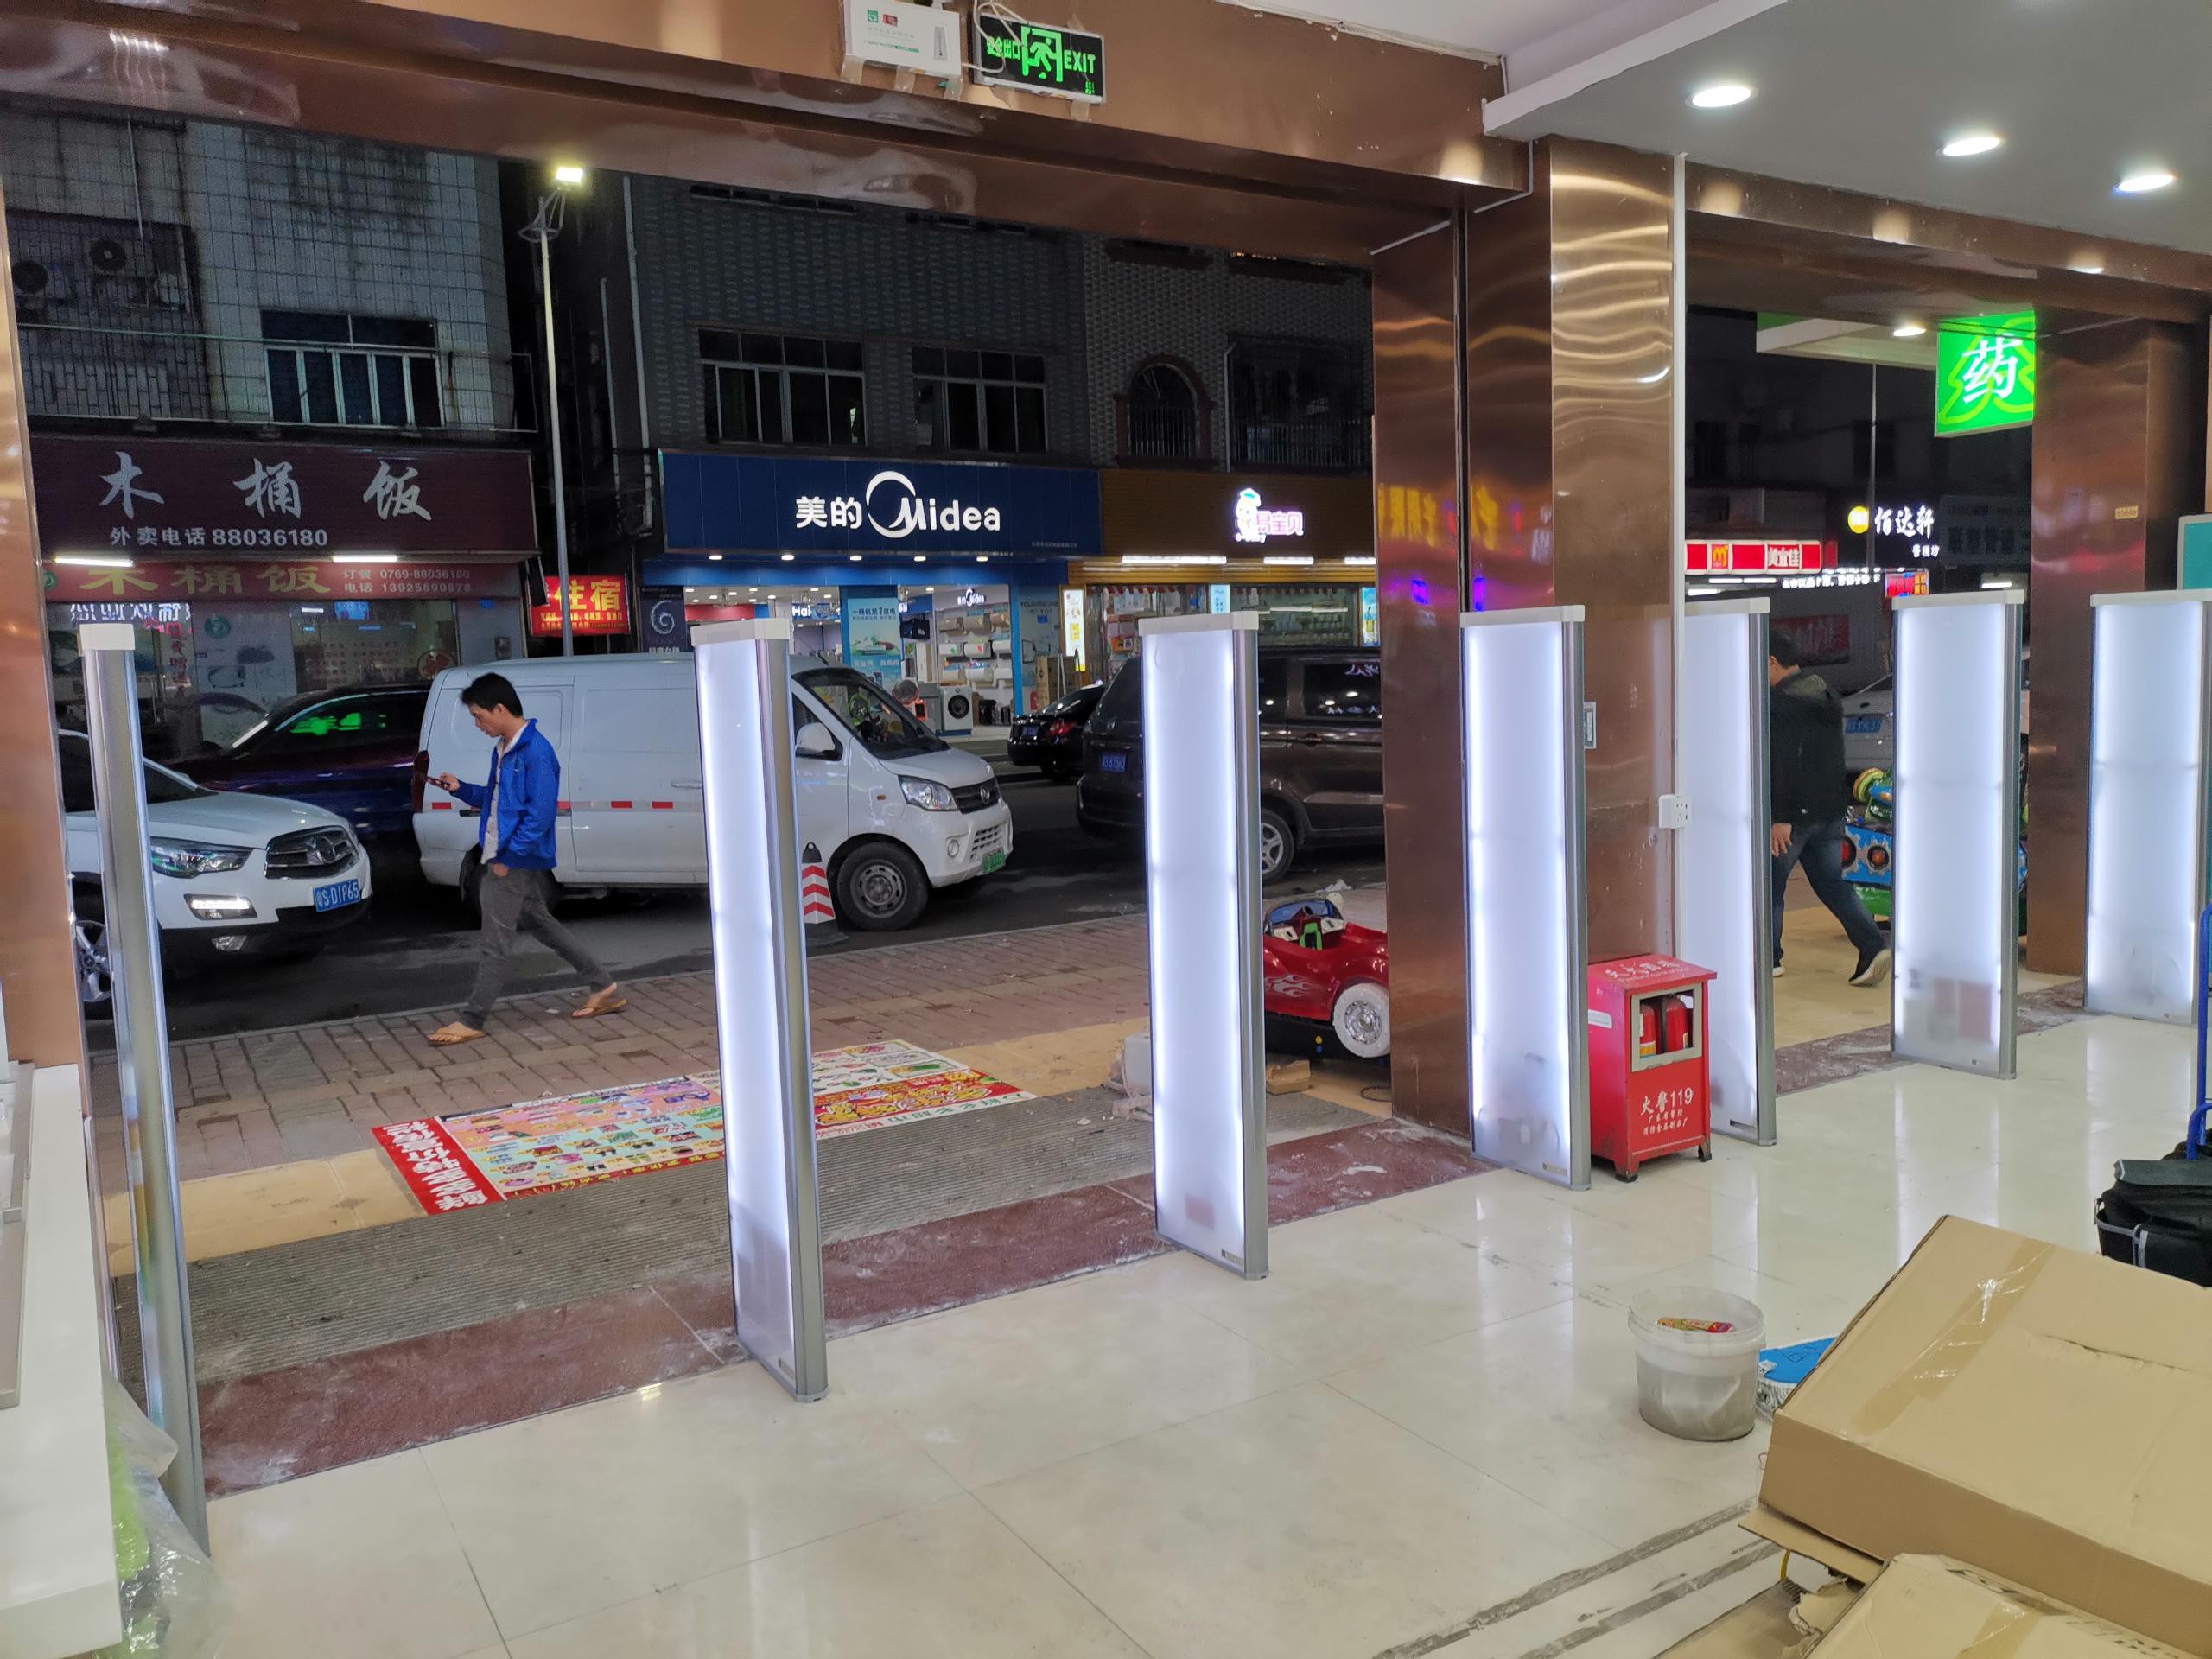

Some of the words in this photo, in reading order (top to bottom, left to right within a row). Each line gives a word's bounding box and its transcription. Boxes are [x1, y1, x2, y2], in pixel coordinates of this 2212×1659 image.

[1064, 49, 1096, 74] EXIT
[1962, 334, 2024, 404] 药
[99, 451, 432, 521] 木桶饭
[795, 496, 863, 529] 美的
[79, 566, 332, 596] 木桶饭
[554, 579, 621, 611] 住宿
[792, 605, 811, 617] Hai
[1639, 1087, 1694, 1117] 火警119
